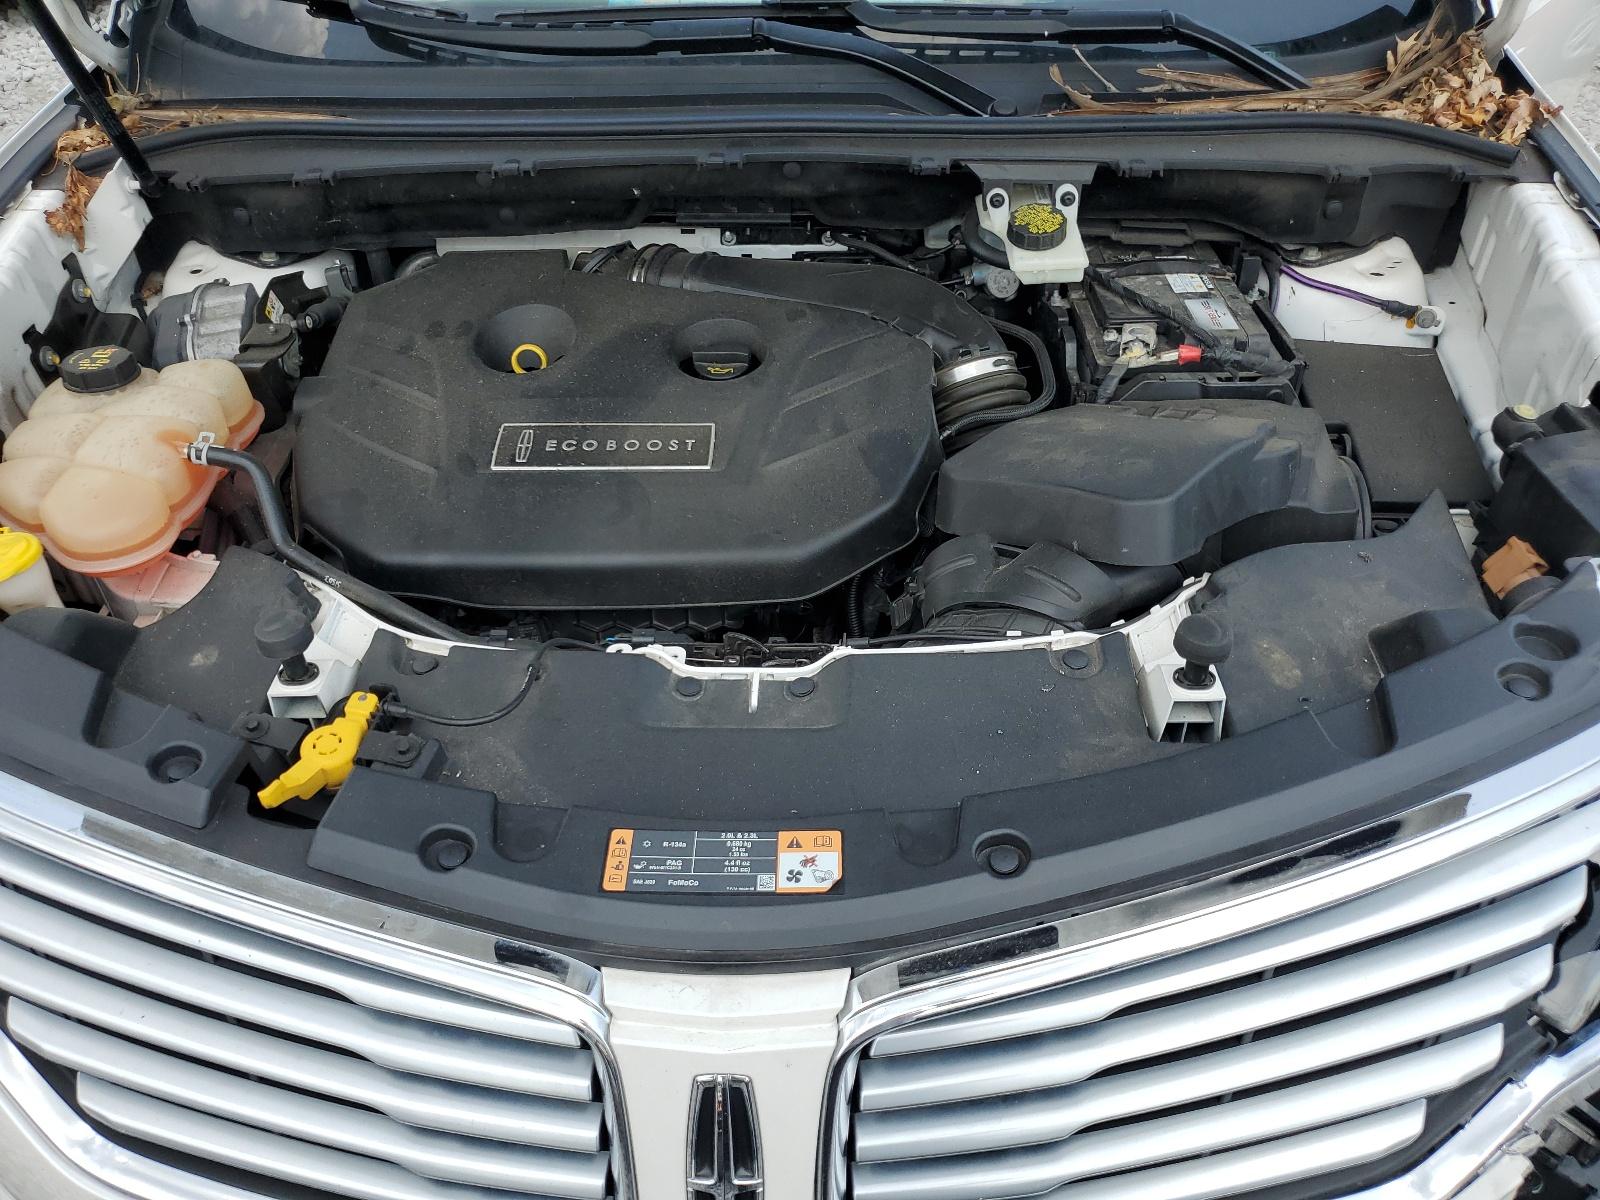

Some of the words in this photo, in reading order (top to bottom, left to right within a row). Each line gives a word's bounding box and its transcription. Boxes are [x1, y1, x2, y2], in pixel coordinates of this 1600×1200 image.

[545, 439, 696, 451] ECOBOOST
[743, 840, 752, 848] kg
[740, 866, 751, 874] cc)
